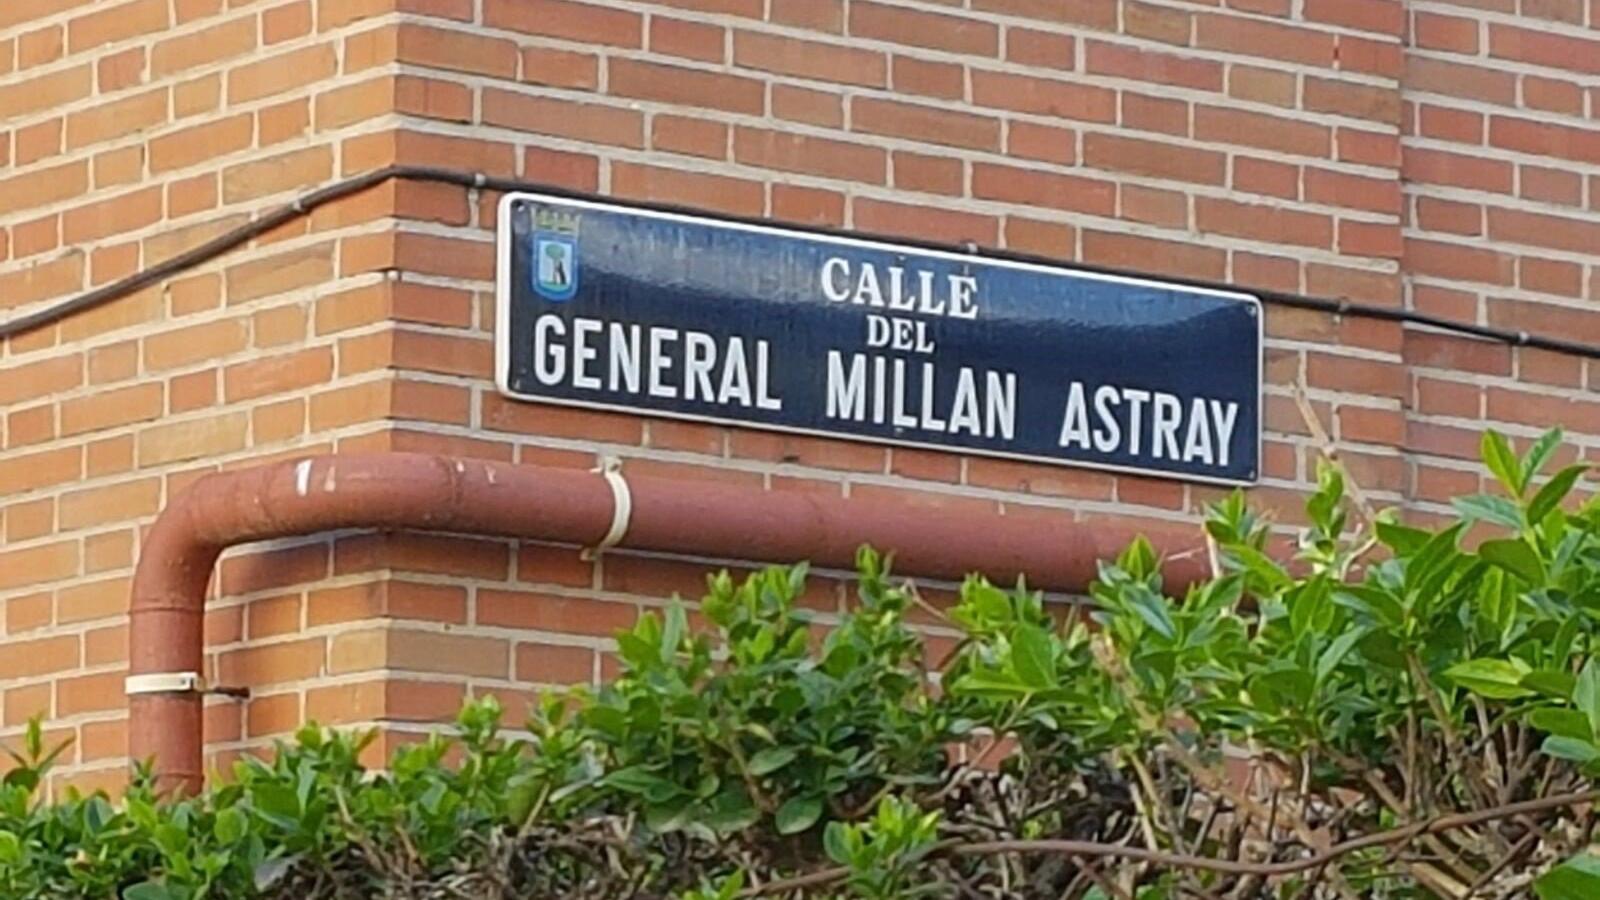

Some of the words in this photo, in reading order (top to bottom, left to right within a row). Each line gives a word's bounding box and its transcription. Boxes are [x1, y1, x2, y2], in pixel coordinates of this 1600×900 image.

[821, 257, 978, 319] CALLE
[867, 314, 934, 353] DEL
[534, 314, 782, 410] GENERAL
[826, 350, 1017, 440] MILLAN
[1060, 381, 1238, 466] ASTRAY
